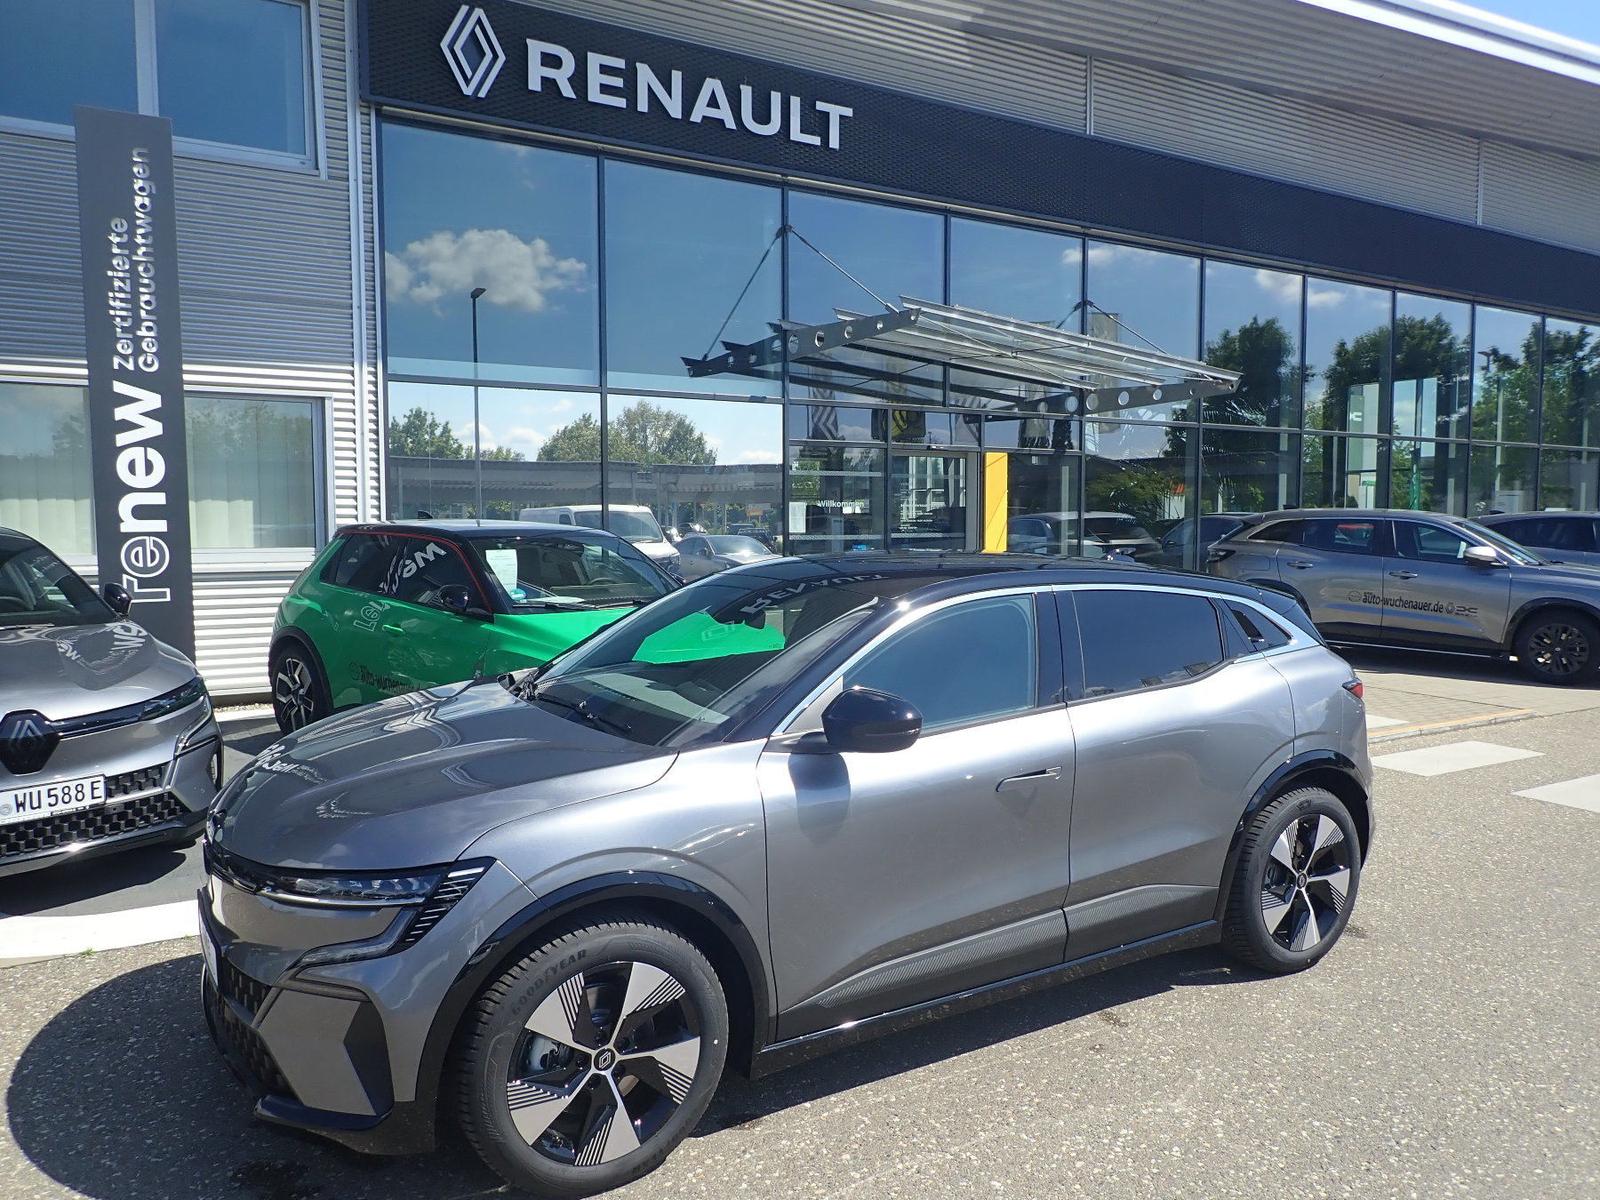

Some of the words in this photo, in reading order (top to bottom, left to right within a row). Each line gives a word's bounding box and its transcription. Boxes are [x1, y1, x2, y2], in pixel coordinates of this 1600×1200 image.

[526, 38, 853, 150] RENAULT
[107, 217, 135, 371] Zertifizierte
[132, 148, 160, 373] Gebrauchtwagen
[112, 380, 171, 602] renew
[818, 500, 865, 508] Willkommen
[14, 789, 42, 813] WU
[47, 783, 85, 808] 588
[90, 780, 102, 800] E
